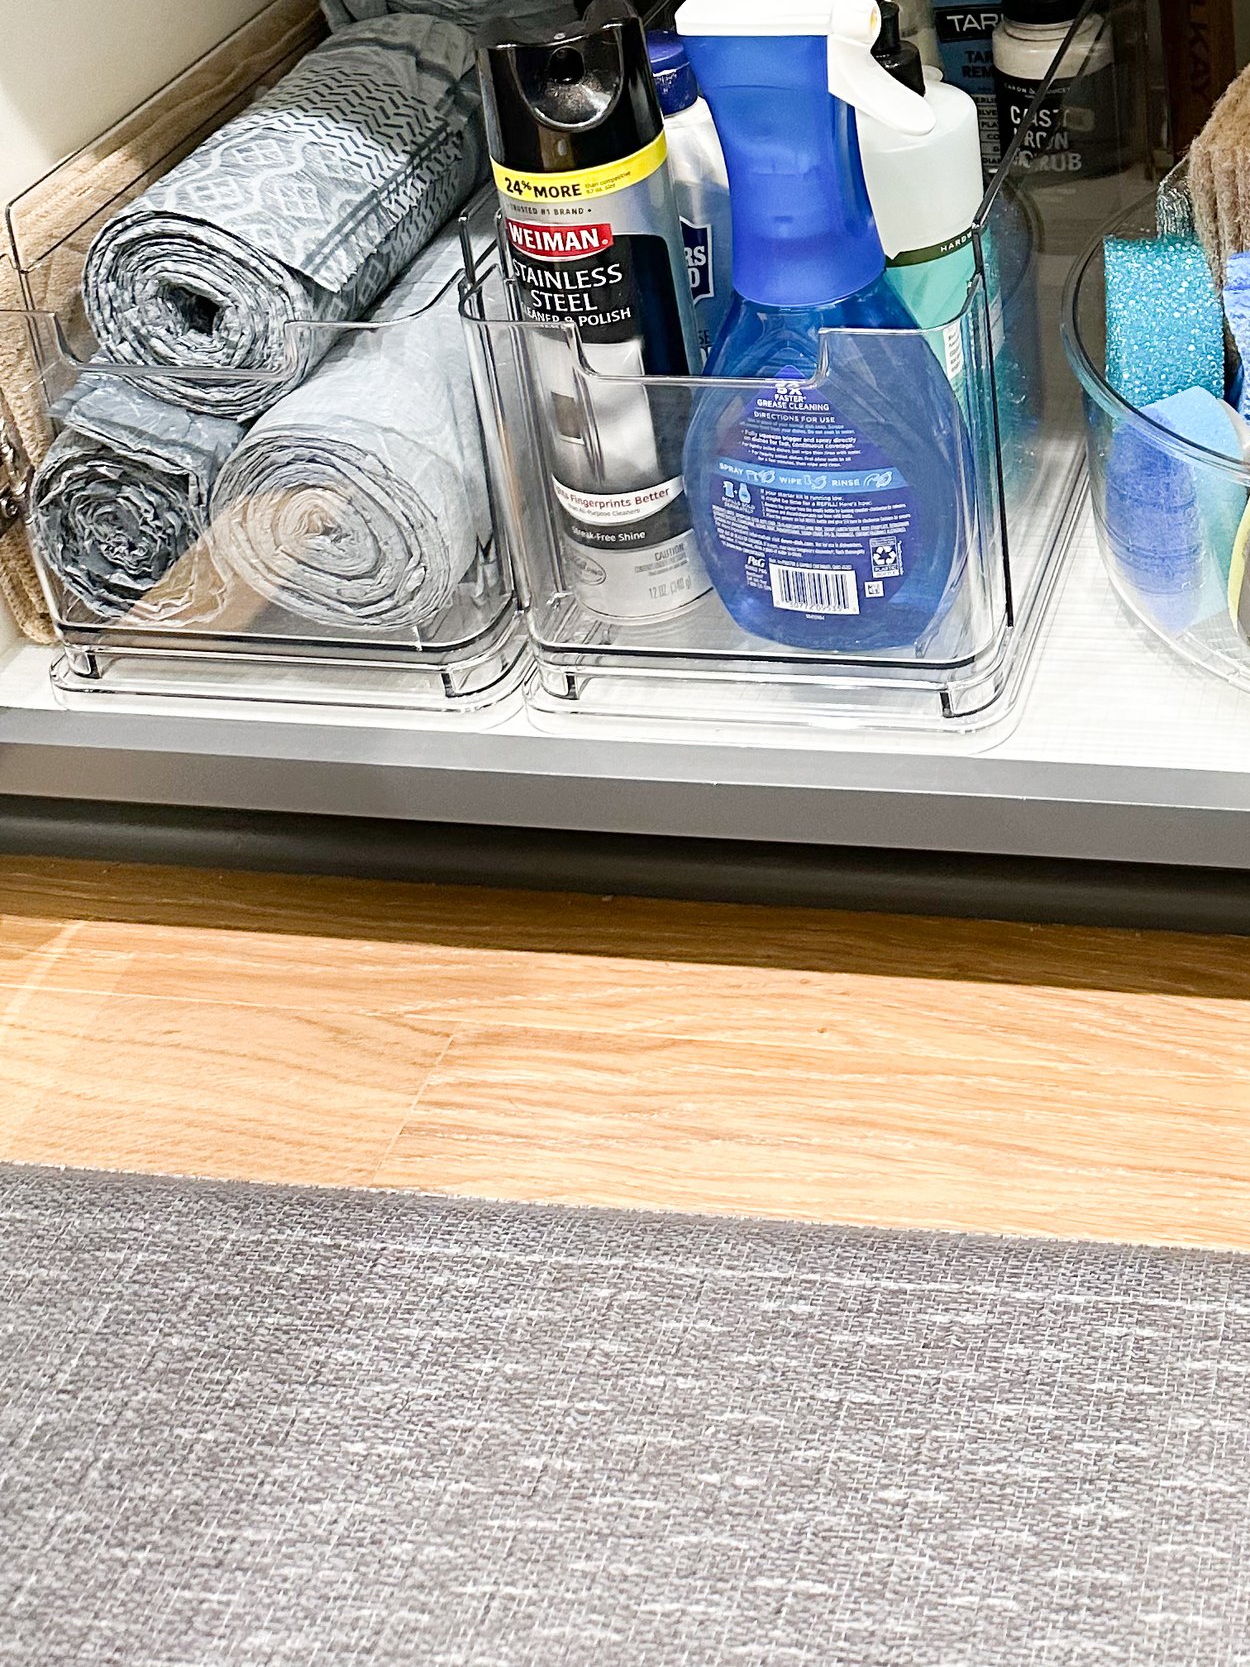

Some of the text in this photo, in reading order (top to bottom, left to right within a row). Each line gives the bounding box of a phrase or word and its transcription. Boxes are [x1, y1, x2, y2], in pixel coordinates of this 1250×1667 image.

[946, 13, 1004, 32] TAR
[965, 50, 993, 64] TAR
[961, 66, 994, 79] REM
[981, 121, 999, 129] PLA
[504, 177, 582, 198] 24% MORE
[554, 207, 584, 216] BRAND
[507, 221, 601, 253] WEIMAN
[940, 231, 972, 253] HARDW
[512, 258, 623, 291] STAINLESS
[530, 289, 598, 313] STEEL
[579, 306, 632, 327] POLISH
[757, 398, 829, 412] GREASE CLEANING
[754, 411, 799, 422] DIRECTIONS
[800, 415, 818, 423] FOR
[819, 416, 836, 424] USE
[719, 462, 860, 487] SPRAY WIPE RINSE
[570, 494, 631, 509] Fingerprints
[634, 487, 670, 505] Better
[618, 530, 646, 542] Shine
